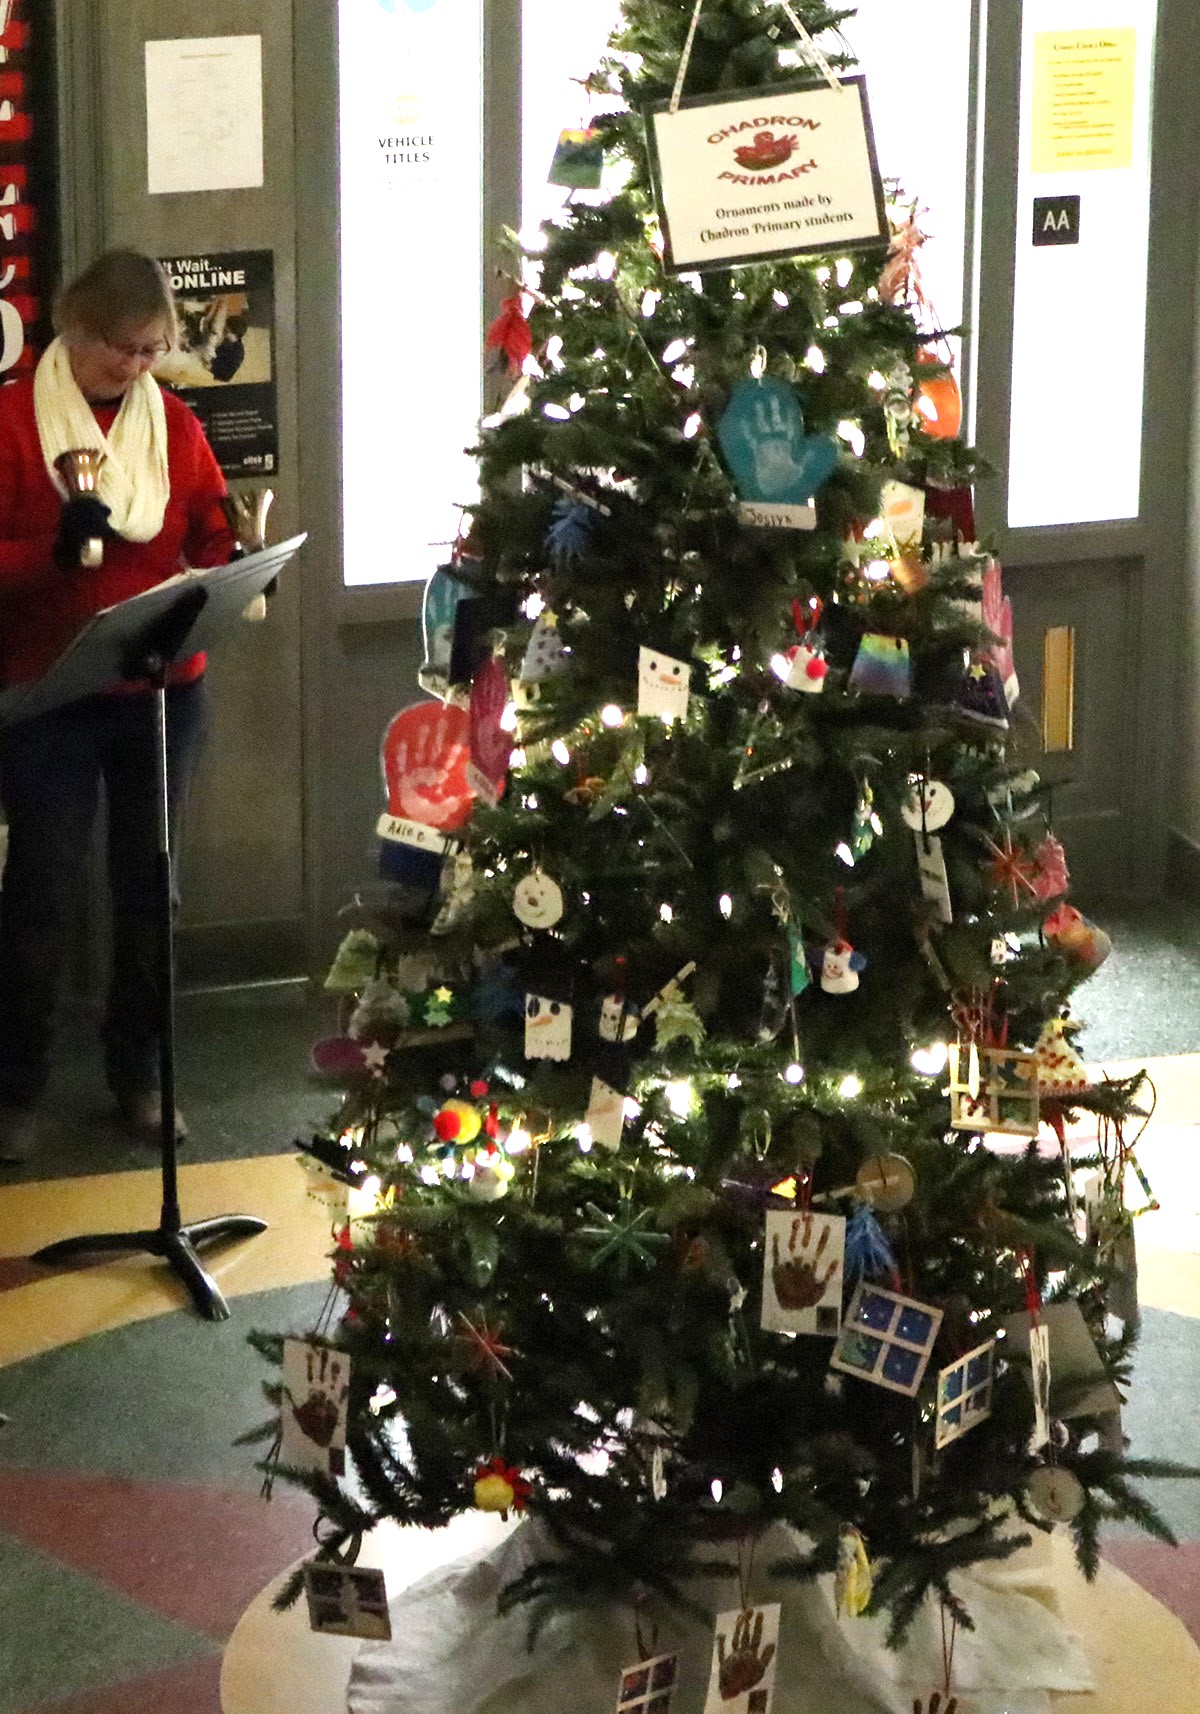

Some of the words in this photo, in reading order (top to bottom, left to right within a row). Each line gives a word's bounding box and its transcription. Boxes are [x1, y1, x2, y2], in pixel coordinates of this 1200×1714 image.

[707, 115, 821, 145] CHADRON
[378, 136, 435, 148] VEHICLE
[385, 152, 430, 164] TITLES
[717, 159, 818, 186] PRIMARY
[716, 203, 781, 220] Ornaments
[784, 197, 814, 210] made
[818, 193, 832, 205] by
[700, 225, 750, 243] Chadron
[752, 219, 802, 234] Primary
[804, 211, 854, 228] students
[1043, 210, 1070, 231] AA
[176, 258, 223, 274] Wait...
[169, 270, 246, 291] ONLINE
